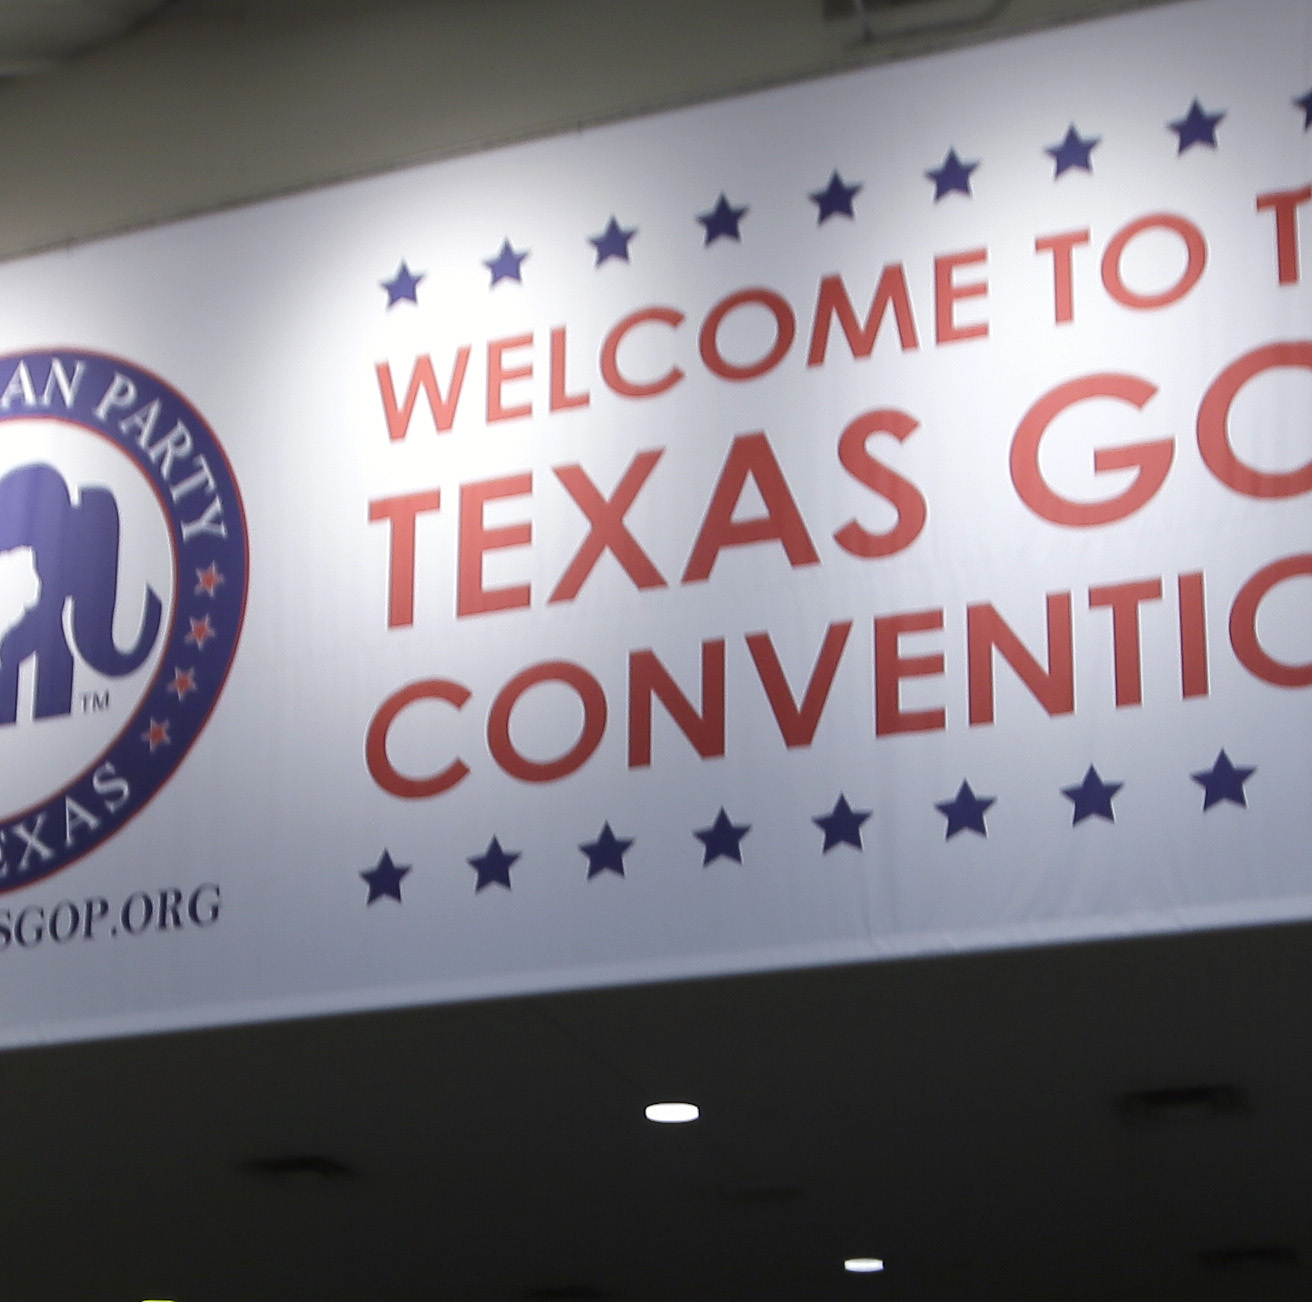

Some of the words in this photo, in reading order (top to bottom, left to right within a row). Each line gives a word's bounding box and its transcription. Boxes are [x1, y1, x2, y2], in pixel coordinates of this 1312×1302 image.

[374, 247, 990, 443] WELCOME
[1034, 212, 1208, 326] TO
[94, 372, 227, 544] PARTY
[367, 408, 928, 631] TEXAS
[79, 690, 111, 714] TM
